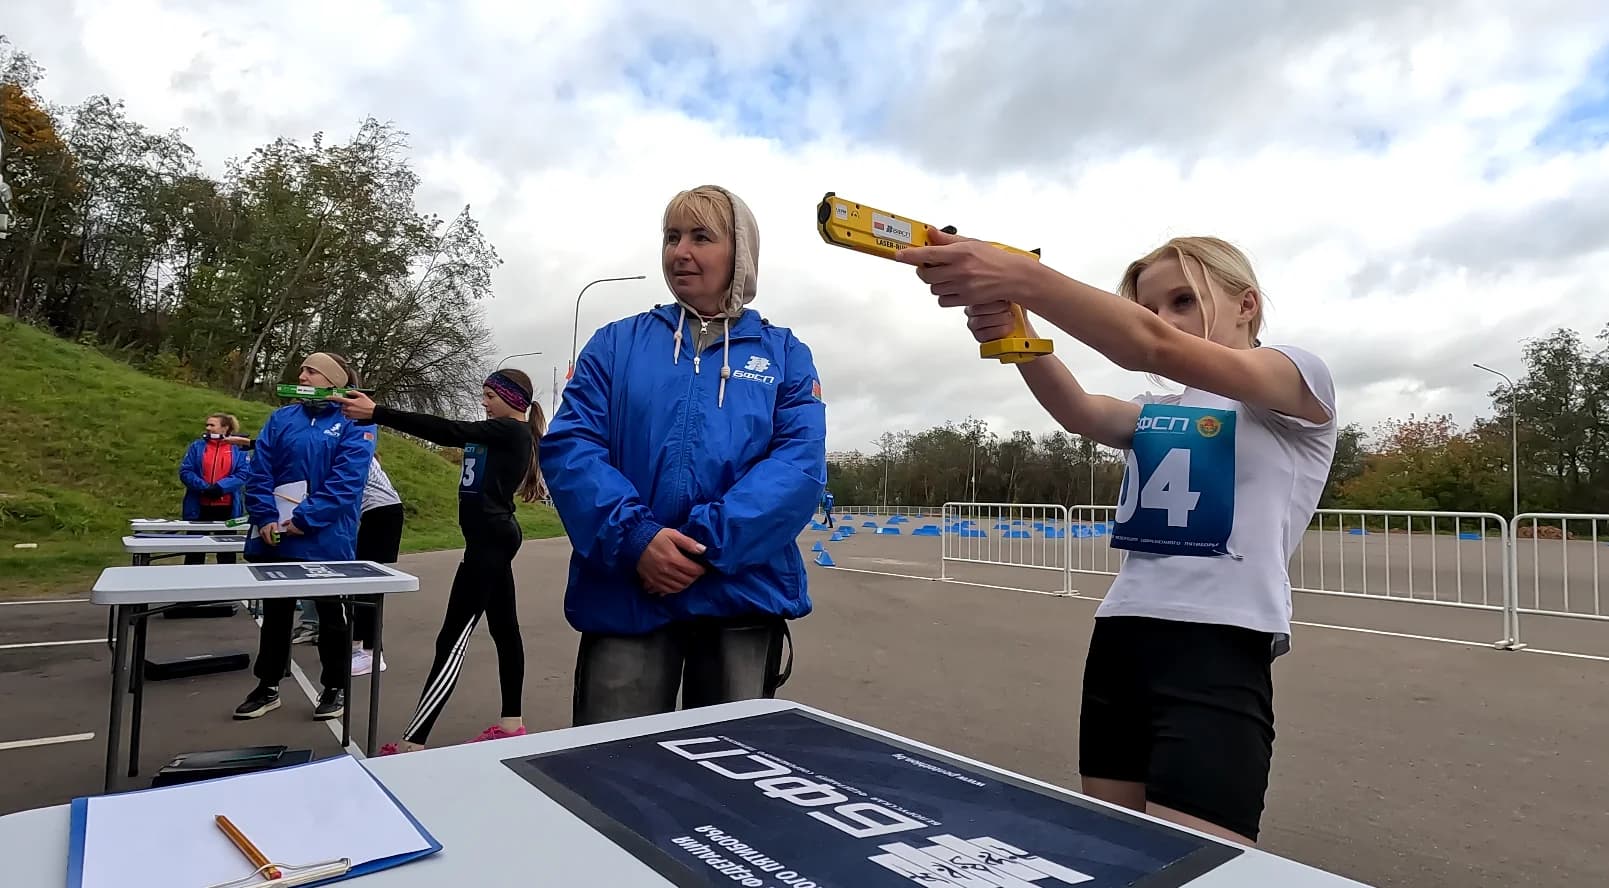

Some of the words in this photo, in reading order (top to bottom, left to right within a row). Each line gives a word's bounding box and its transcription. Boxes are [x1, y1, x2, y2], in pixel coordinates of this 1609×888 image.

[733, 370, 775, 385] БФСП
[1136, 416, 1189, 431] ФСП
[657, 736, 929, 839] БФСП
[671, 836, 764, 888] ФЕДЕРАЦИЯ
[694, 825, 785, 873] ПЯТИБОРЬЯ
